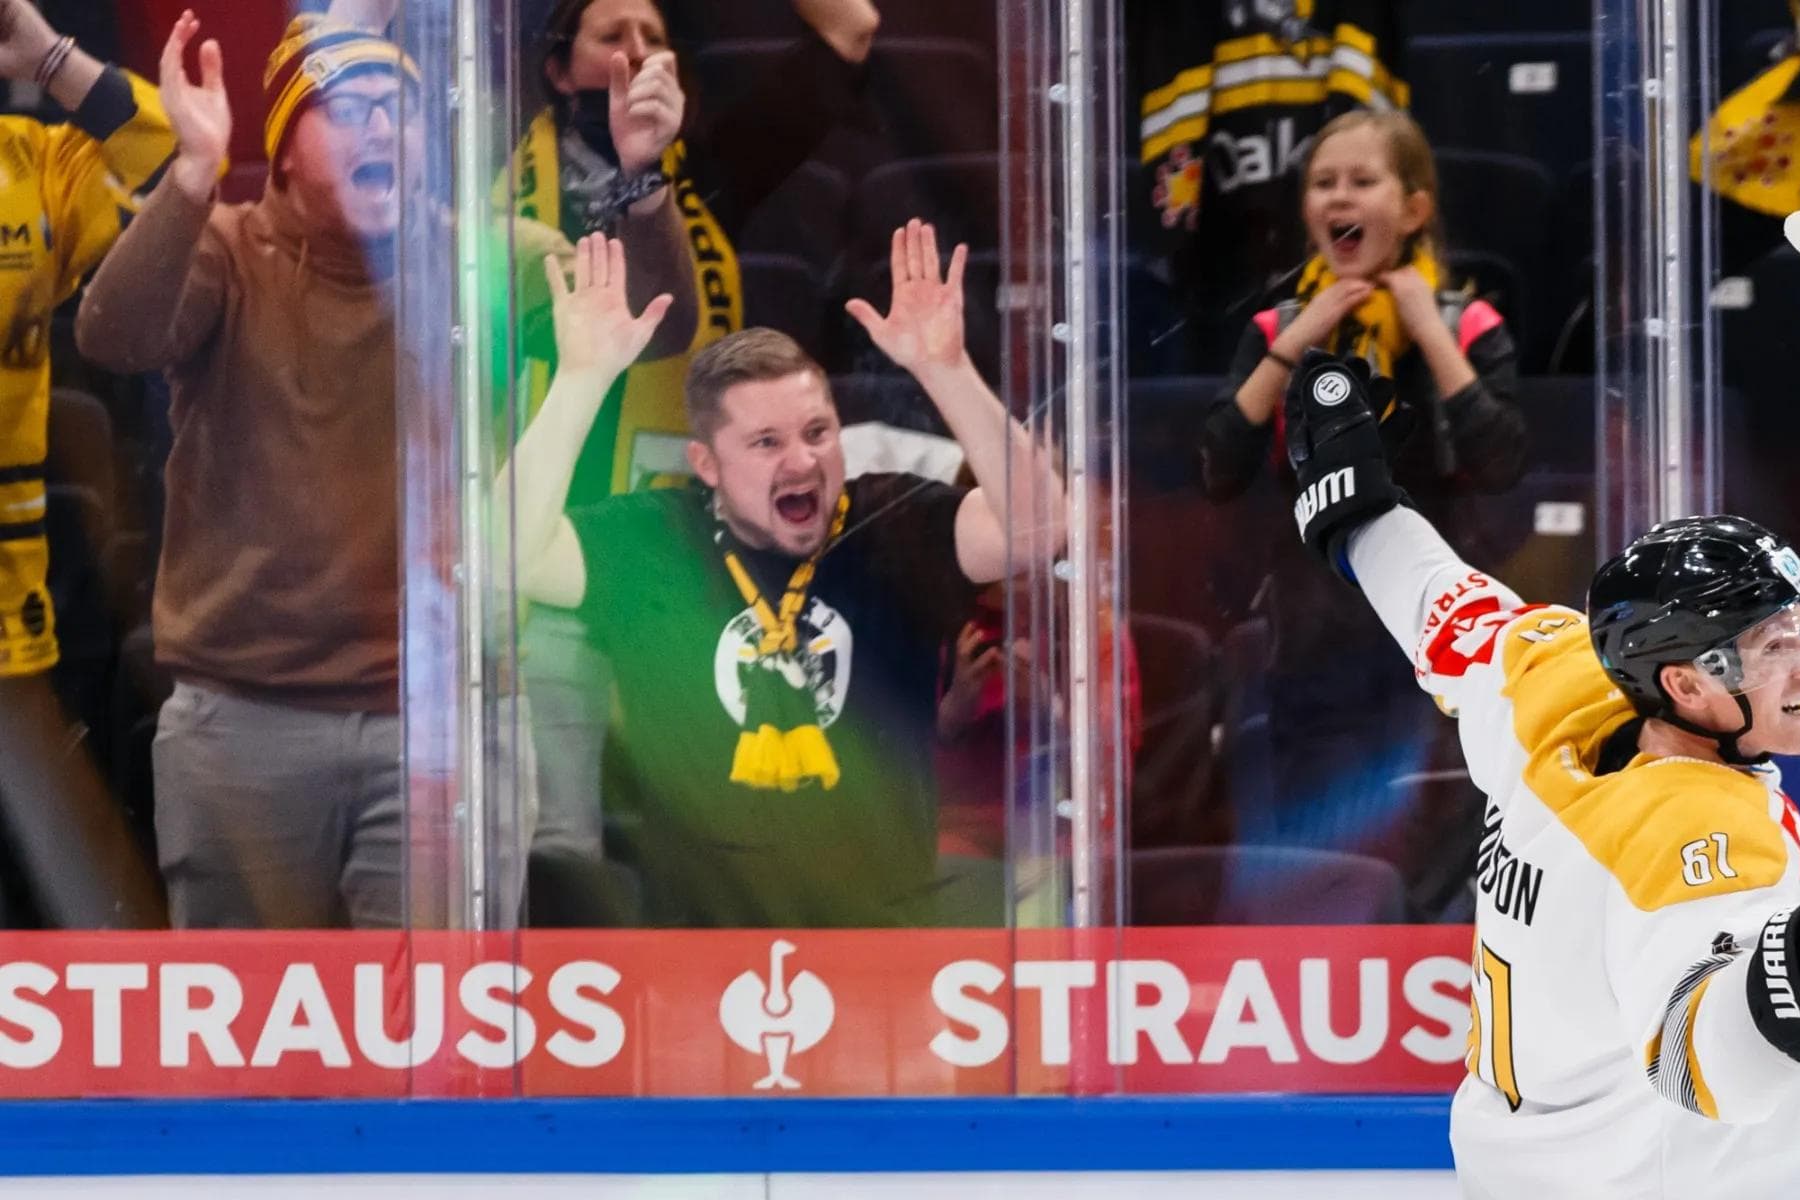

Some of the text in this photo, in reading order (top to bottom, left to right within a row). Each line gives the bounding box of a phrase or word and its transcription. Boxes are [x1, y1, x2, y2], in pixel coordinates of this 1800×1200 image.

[1680, 832, 1738, 887] 61
[0, 960, 627, 1069] STRAUSS
[929, 956, 1474, 1068] STRAUS
